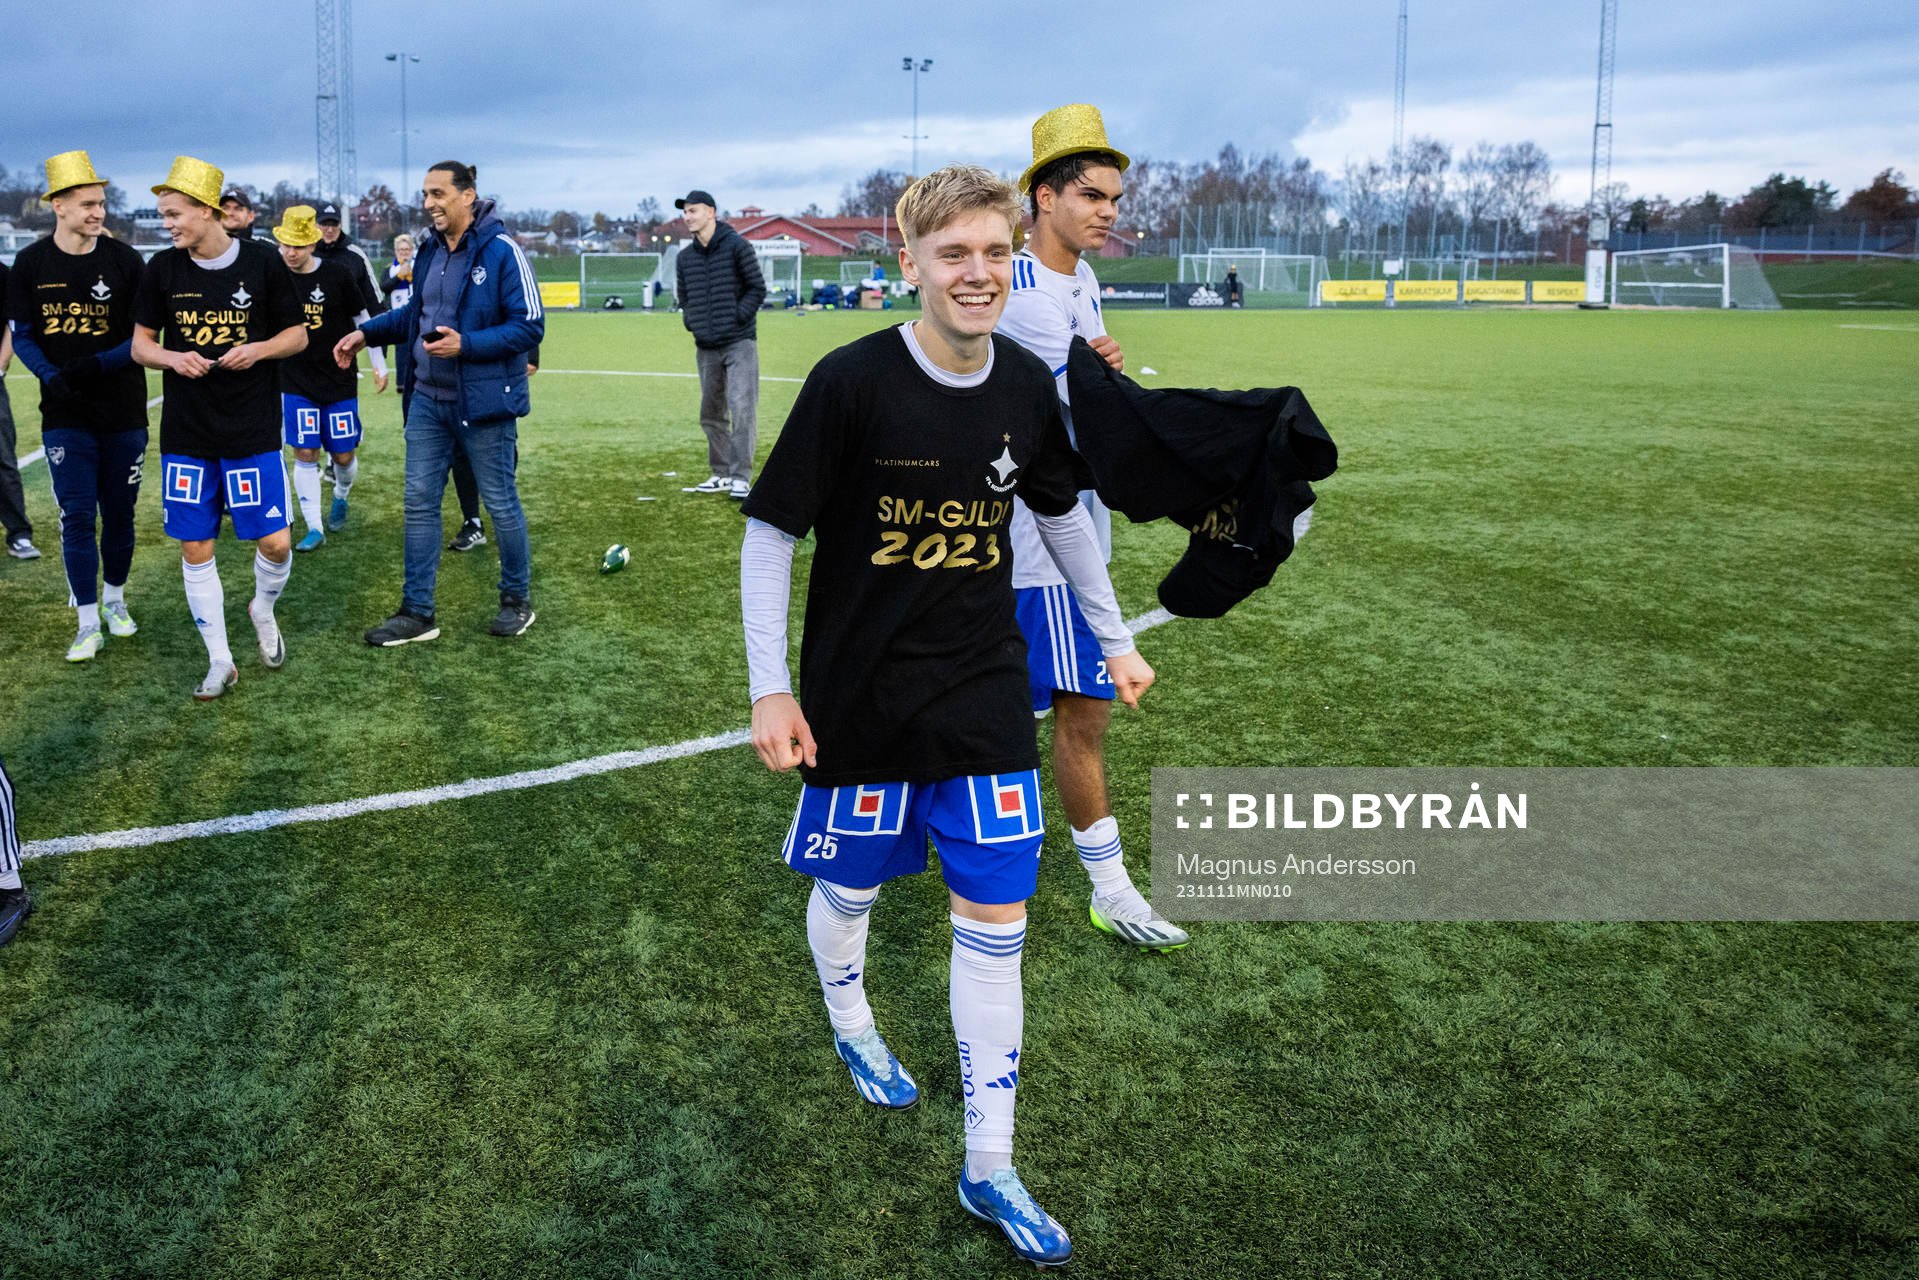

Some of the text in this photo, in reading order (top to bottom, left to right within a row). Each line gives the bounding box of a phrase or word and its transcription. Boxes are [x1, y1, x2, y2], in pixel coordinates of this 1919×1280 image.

[42, 302, 109, 316] SM-GULD!
[175, 310, 249, 325] SM-GULD!
[43, 317, 109, 336] 2023
[181, 326, 248, 346] 2023
[874, 458, 940, 467] PLATINUMCARS
[877, 495, 1010, 528] SM-GULD!
[871, 531, 1001, 573] 2023
[804, 833, 839, 860] 25
